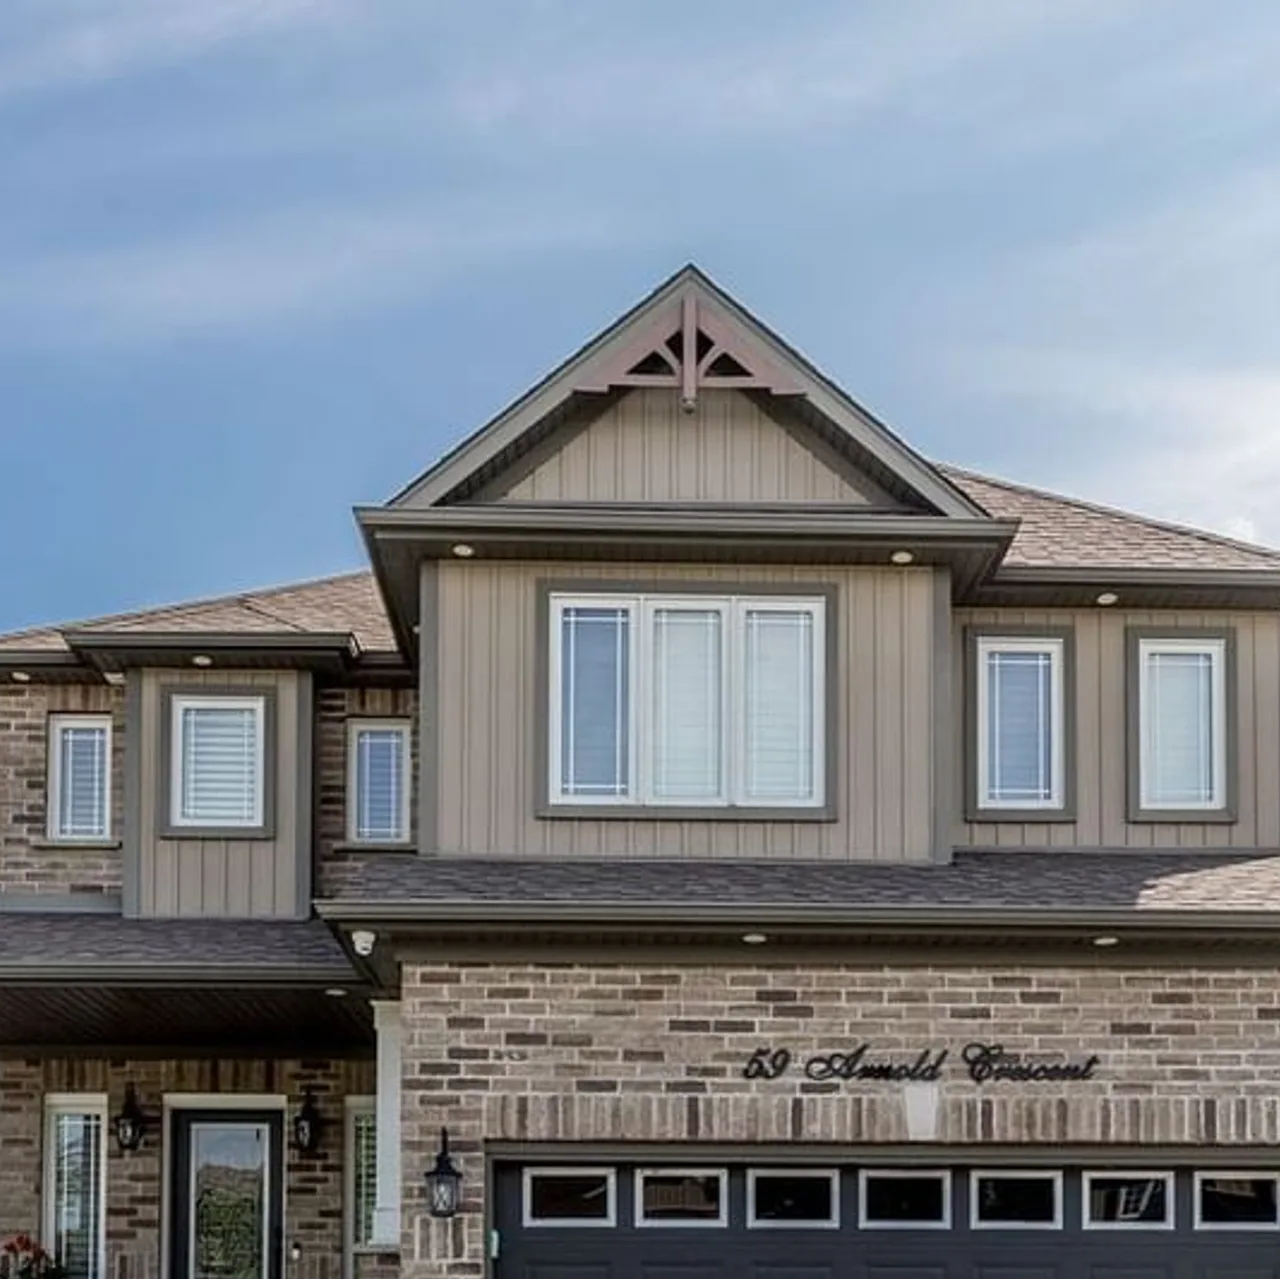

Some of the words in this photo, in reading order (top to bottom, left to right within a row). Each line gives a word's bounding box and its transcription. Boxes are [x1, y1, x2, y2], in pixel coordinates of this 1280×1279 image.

[743, 1048, 791, 1079] 59
[805, 1044, 948, 1081] Arnold
[961, 1043, 1101, 1082] Crescent
